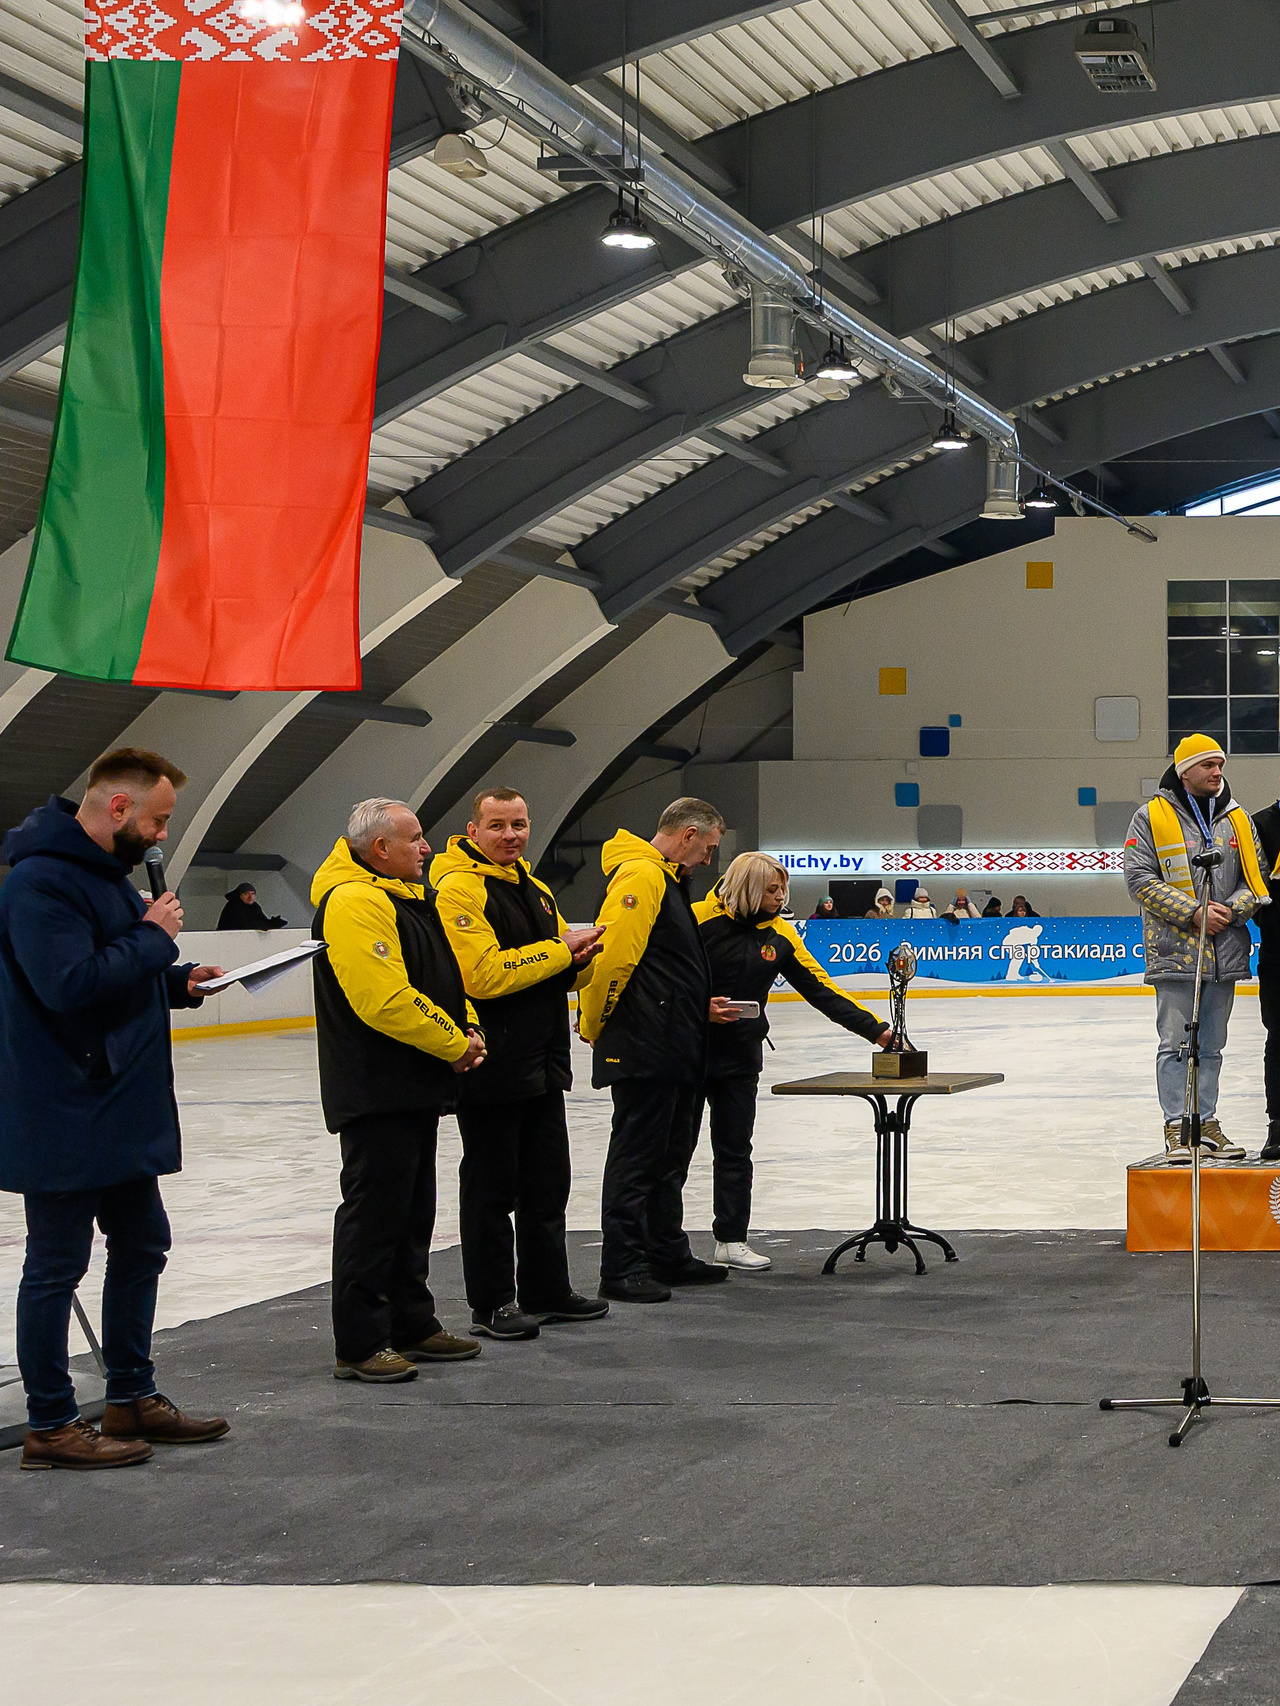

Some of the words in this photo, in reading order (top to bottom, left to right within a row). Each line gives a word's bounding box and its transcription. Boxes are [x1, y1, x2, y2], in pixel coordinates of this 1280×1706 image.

[779, 854, 864, 871] ilichy.by
[503, 951, 549, 970] BELARUS
[828, 942, 882, 963] 2026
[988, 943, 1127, 964] спартакиада
